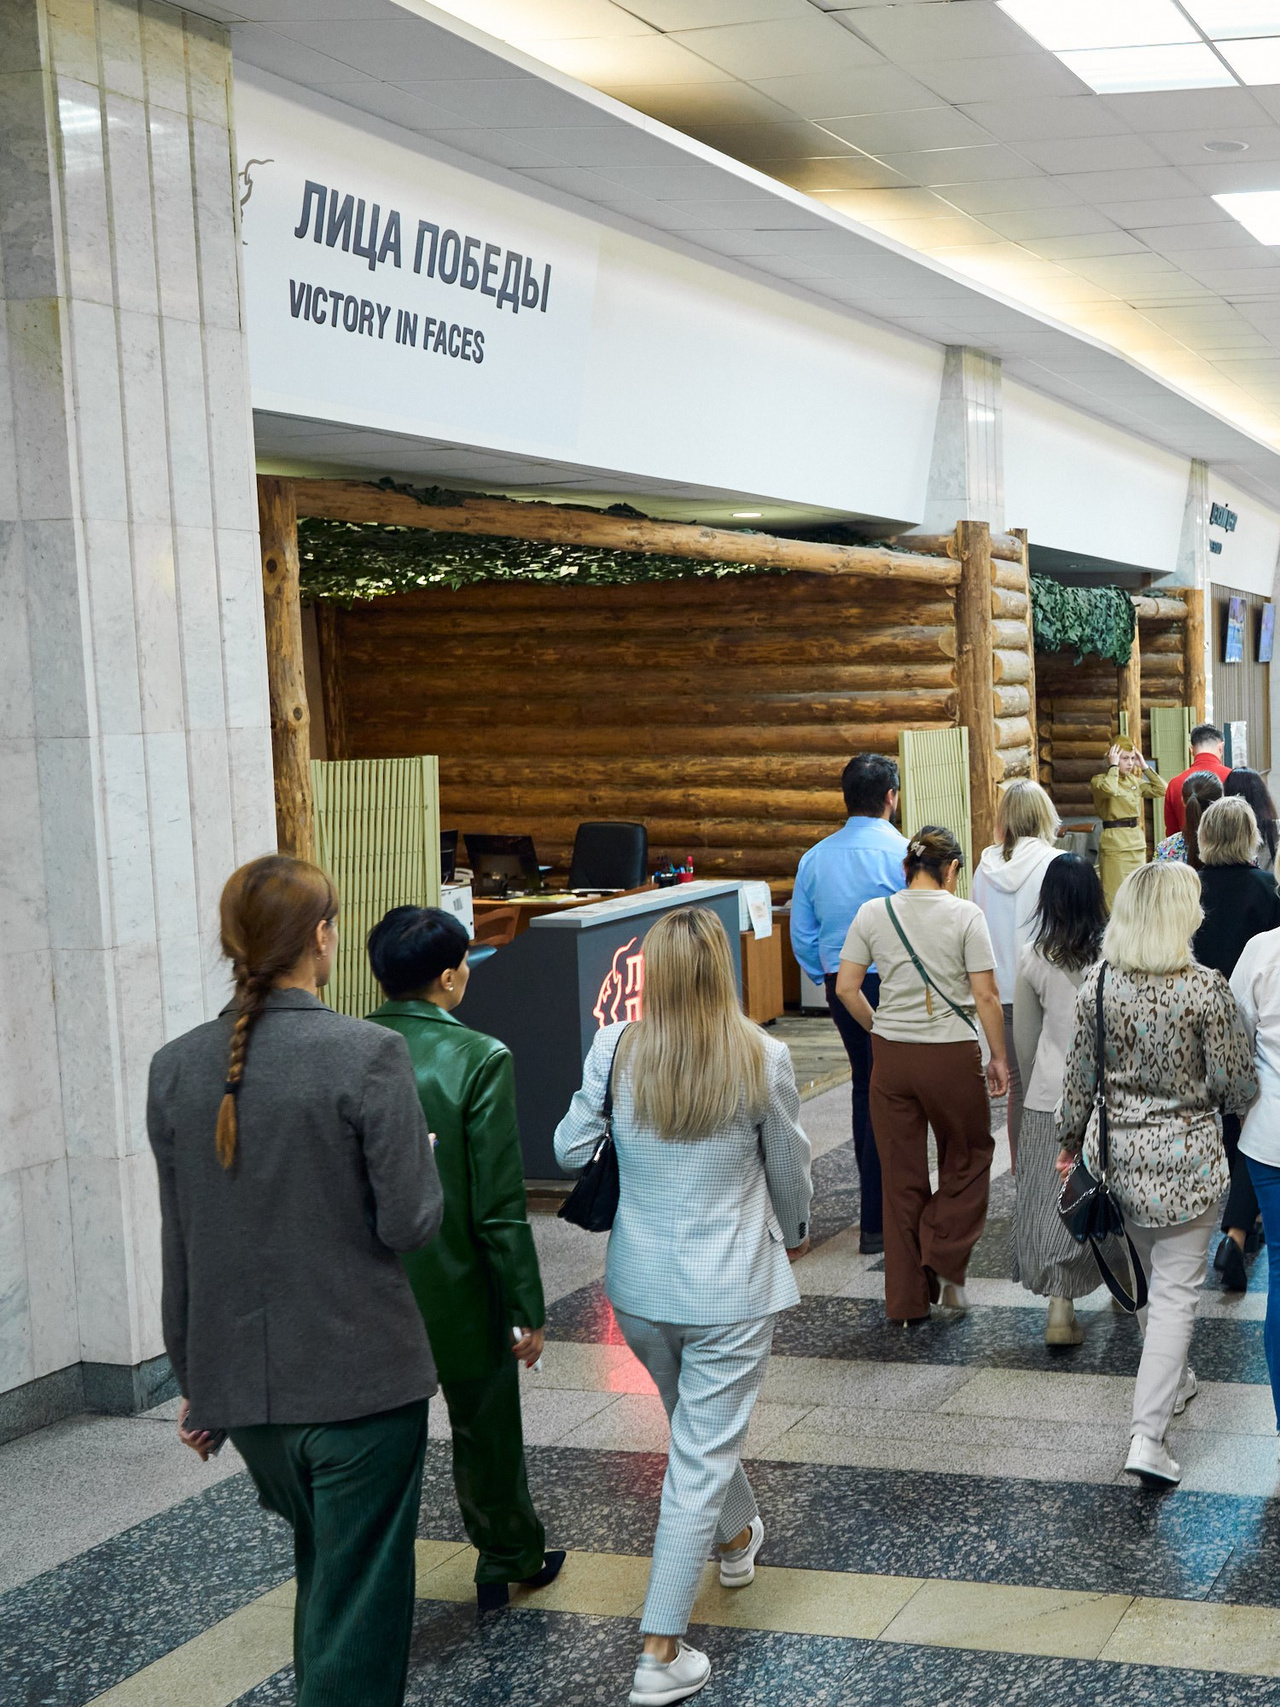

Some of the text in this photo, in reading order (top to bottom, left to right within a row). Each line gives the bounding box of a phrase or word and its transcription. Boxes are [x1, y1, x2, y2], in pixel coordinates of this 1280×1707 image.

[294, 179, 553, 314] ЛИЦА ПОБЕДЫ
[289, 278, 486, 365] VICTORY IN FACES
